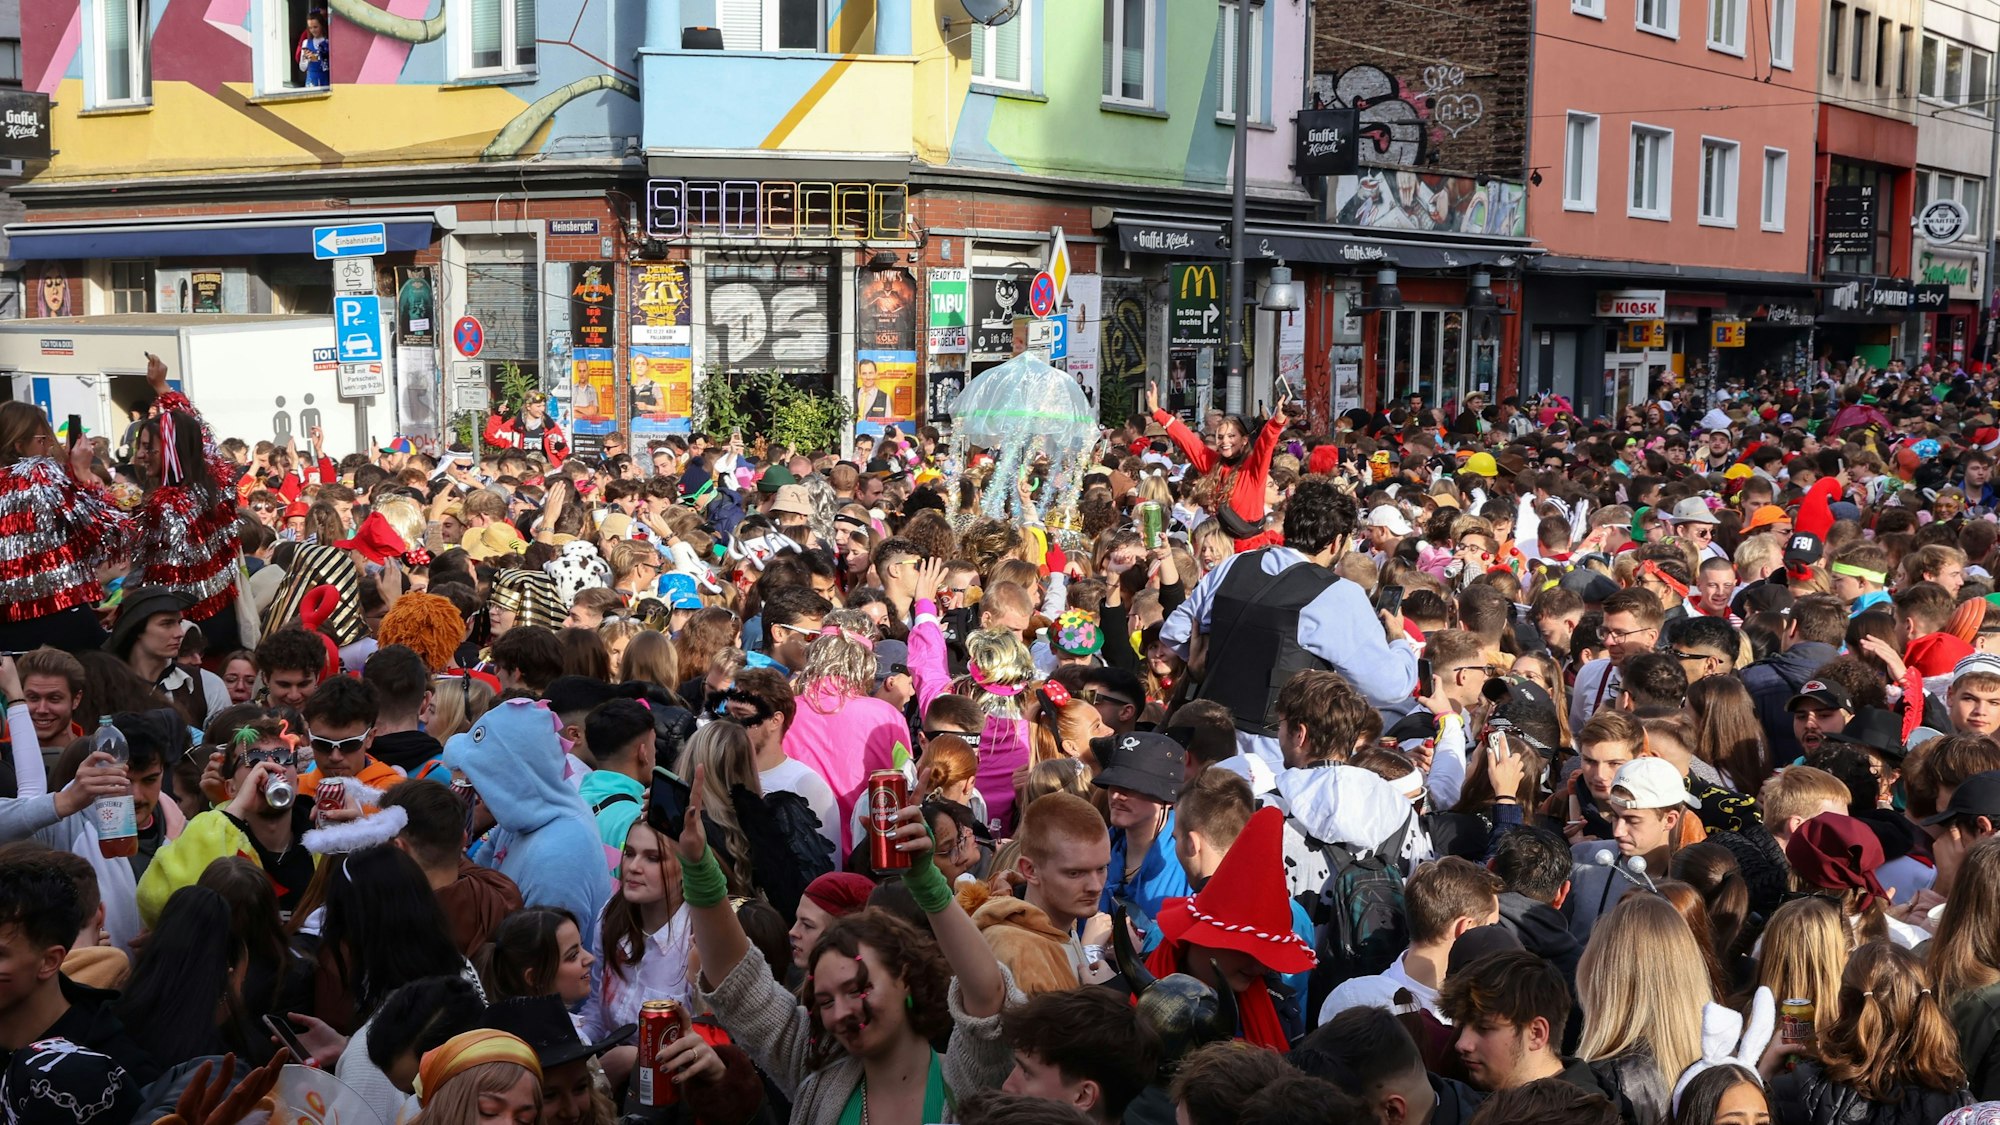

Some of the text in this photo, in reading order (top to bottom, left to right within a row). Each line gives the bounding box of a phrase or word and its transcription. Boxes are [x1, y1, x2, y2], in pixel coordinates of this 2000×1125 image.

[6, 109, 39, 126] Gaffel
[5, 124, 39, 140] Kölsch
[1308, 128, 1339, 143] Gaffel
[1306, 142, 1338, 157] Kölsch
[552, 221, 594, 233] Heinsbergstr.
[335, 236, 381, 246] Einbahnstraße
[1139, 230, 1190, 250] Gaffel Kölsch
[645, 265, 677, 274] DEINE
[932, 271, 961, 280] READY TO
[638, 272, 685, 283] FREUNDE
[933, 293, 963, 313] TABU
[1918, 290, 1944, 306] sky
[341, 300, 361, 326] P
[1615, 302, 1657, 314] KIOSK
[1790, 315, 1814, 325] DELIVERY
[930, 328, 966, 337] SCHAUSPIEL
[1050, 320, 1064, 354] P
[313, 350, 331, 360] TOI
[1792, 536, 1813, 551] FBI
